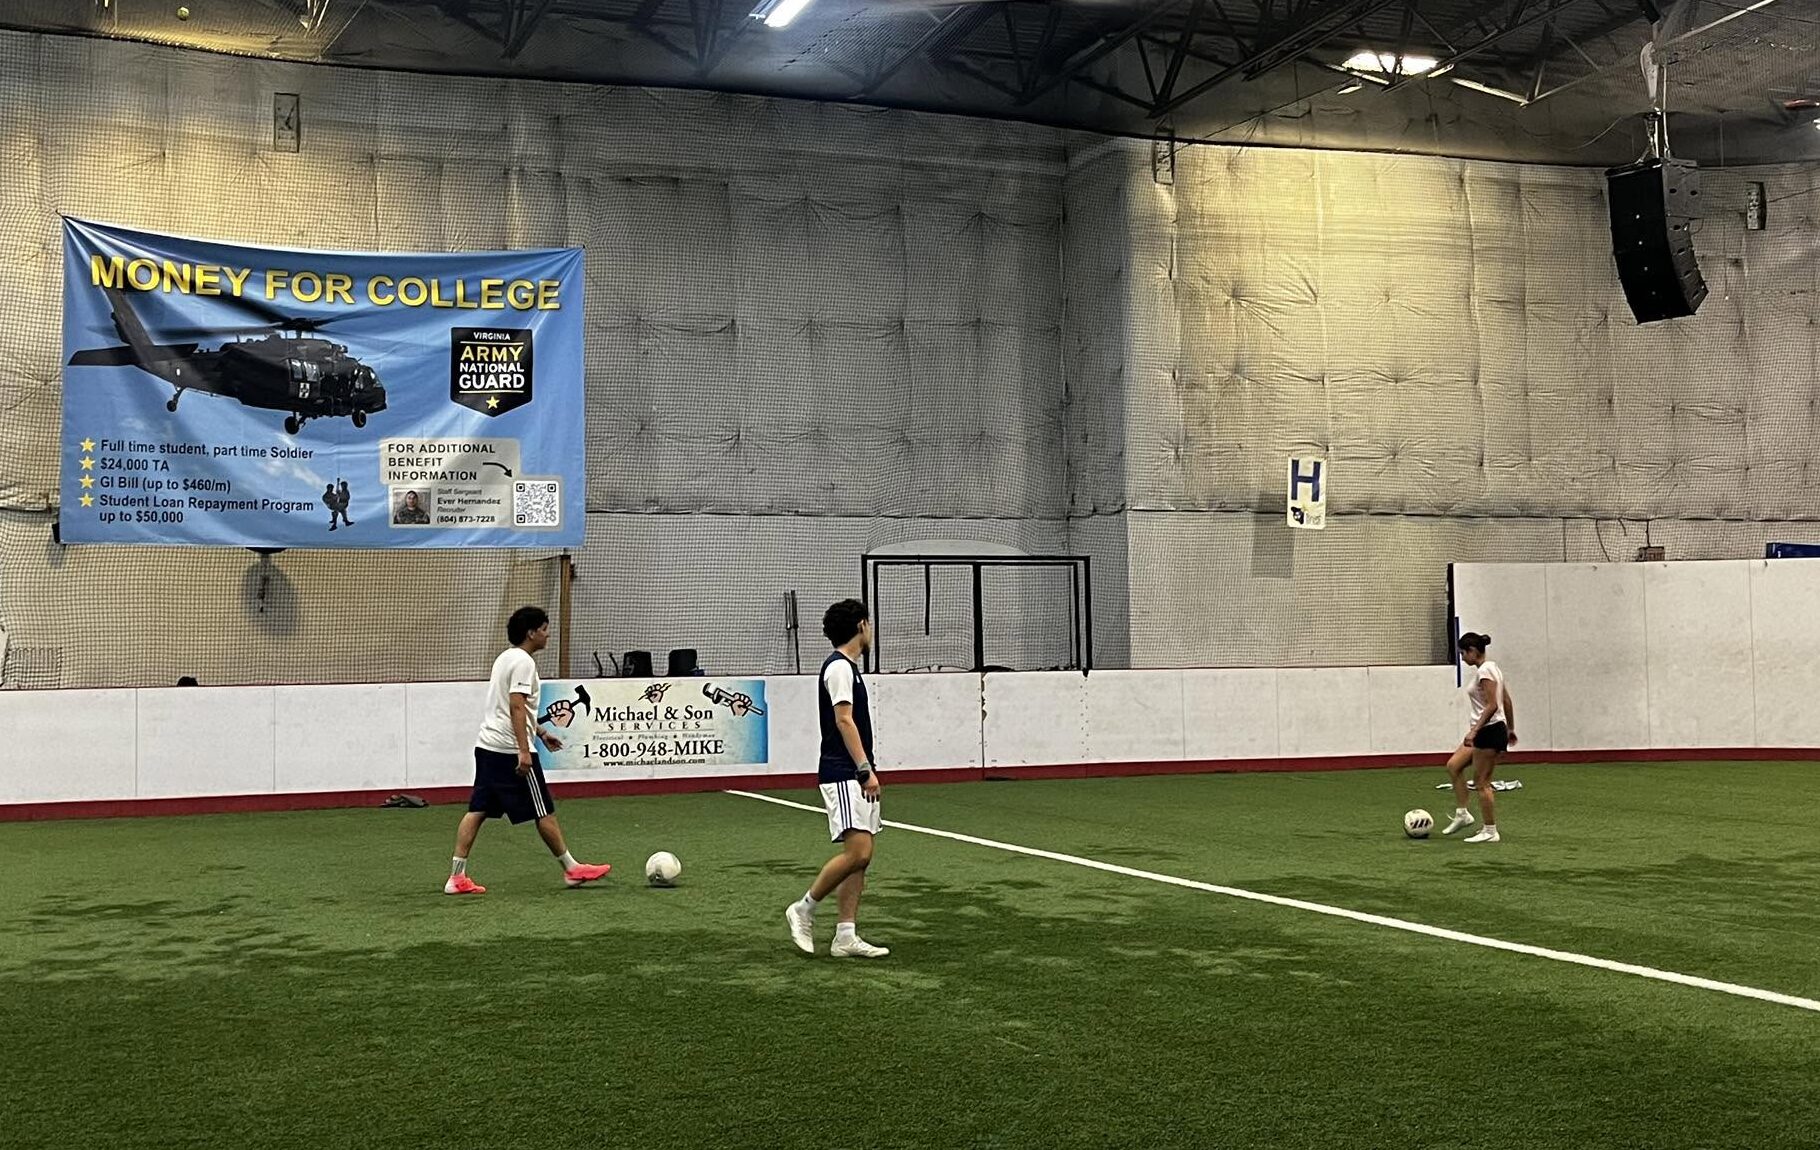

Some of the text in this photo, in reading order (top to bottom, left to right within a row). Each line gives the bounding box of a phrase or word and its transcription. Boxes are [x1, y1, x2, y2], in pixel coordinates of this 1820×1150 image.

[90, 255, 561, 310] MONEY FOR COLLEGE
[473, 332, 511, 340] VIRGINIA
[460, 345, 524, 362] ARMY
[459, 362, 525, 373] NATIONAL
[459, 374, 525, 389] GUARD
[101, 440, 314, 459] Full time student, part time Soldier
[388, 443, 496, 454] FOR ADDITIONAL
[100, 458, 170, 472] $24,000 TA
[388, 457, 443, 467] BENEFIT
[388, 471, 477, 481] INFORMATION
[1291, 459, 1321, 502] H
[100, 476, 231, 493] GI Bill (up to $460/m)
[99, 495, 314, 514] Student Loan Repayment Program
[99, 510, 184, 524] up to $50,000
[594, 705, 714, 722] Michael & Son
[607, 721, 702, 732] SERVICES
[584, 740, 725, 758] 1-800-948-MIKE
[603, 757, 706, 767] www.michaelandson.com
